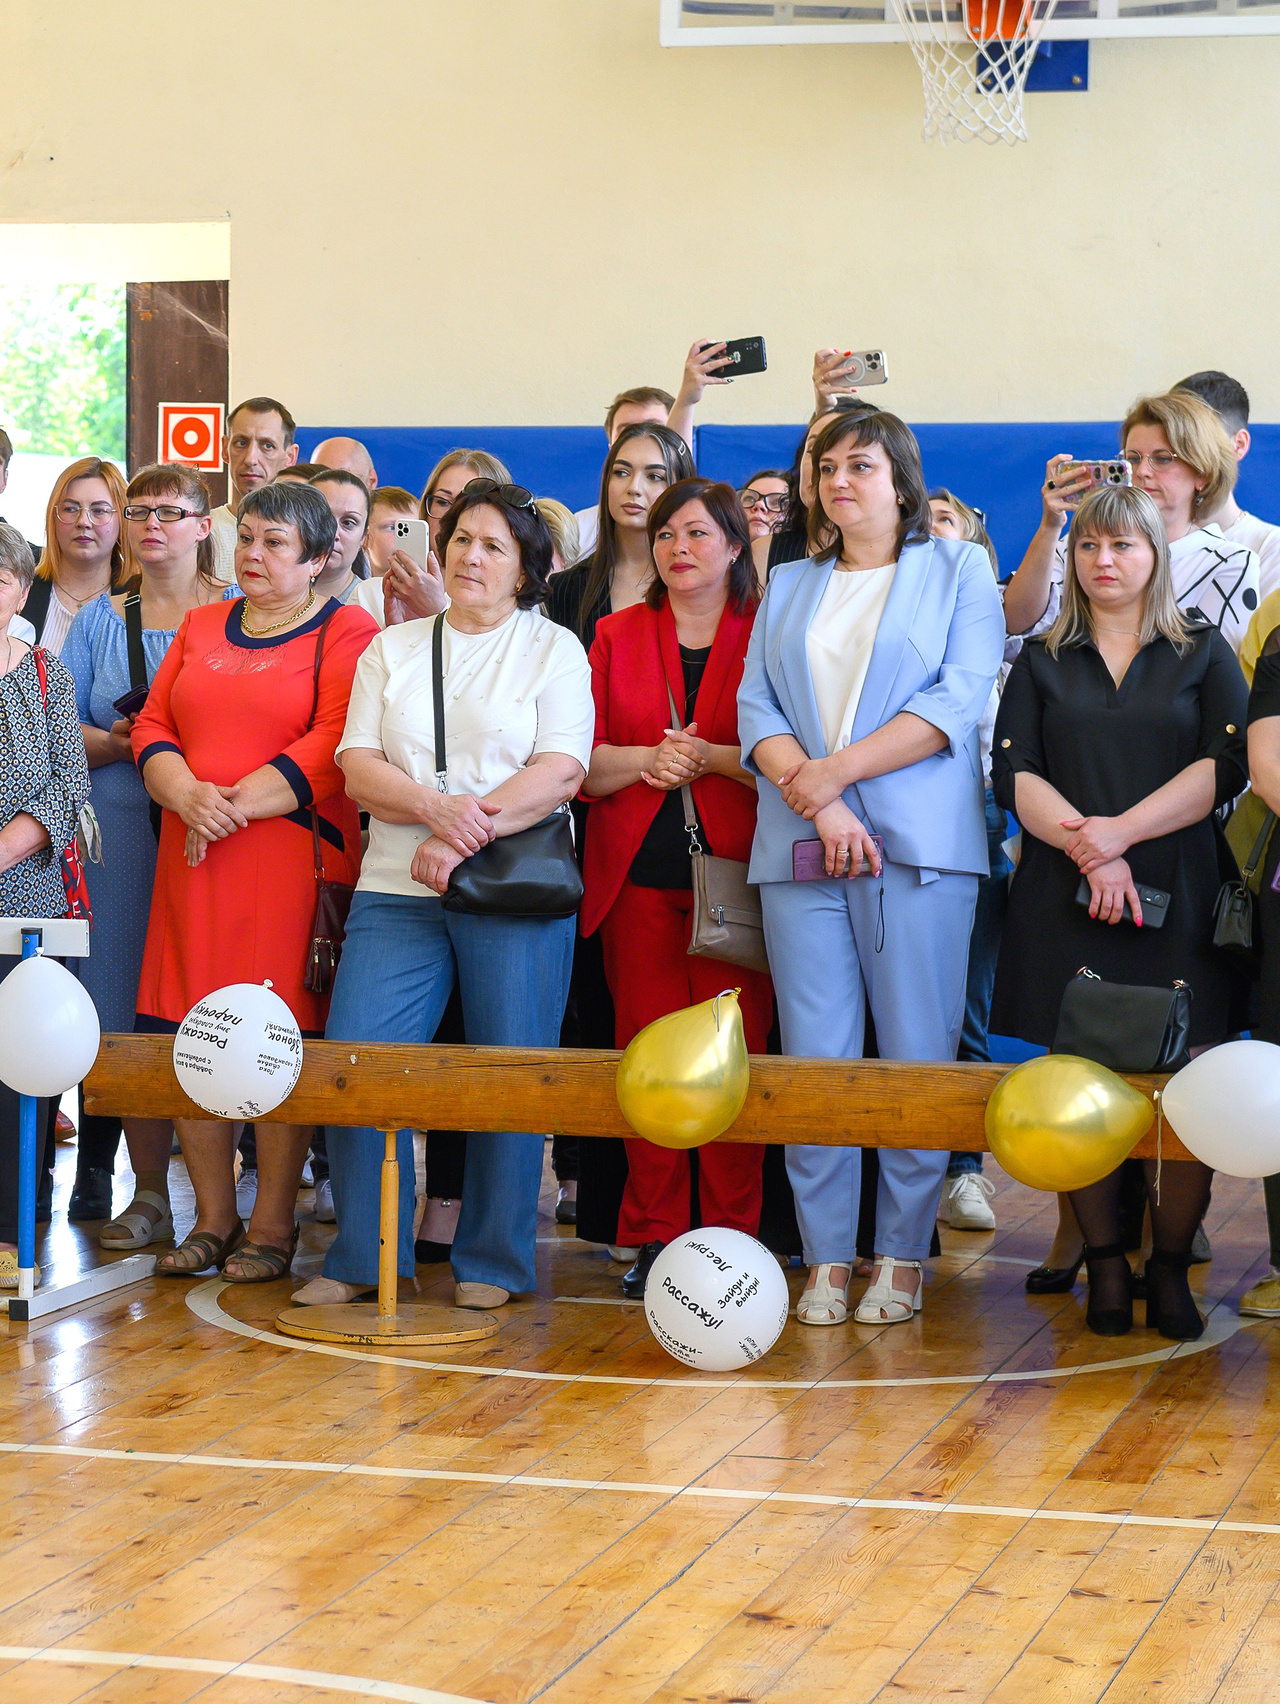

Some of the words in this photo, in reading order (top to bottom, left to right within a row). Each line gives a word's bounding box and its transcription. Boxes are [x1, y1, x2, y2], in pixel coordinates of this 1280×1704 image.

[684, 1241, 711, 1255] рук!
[707, 1251, 733, 1272] Лес
[662, 1276, 724, 1330] Рассажу!
[717, 1281, 745, 1309] Зайди
[735, 1277, 761, 1308] выйди!
